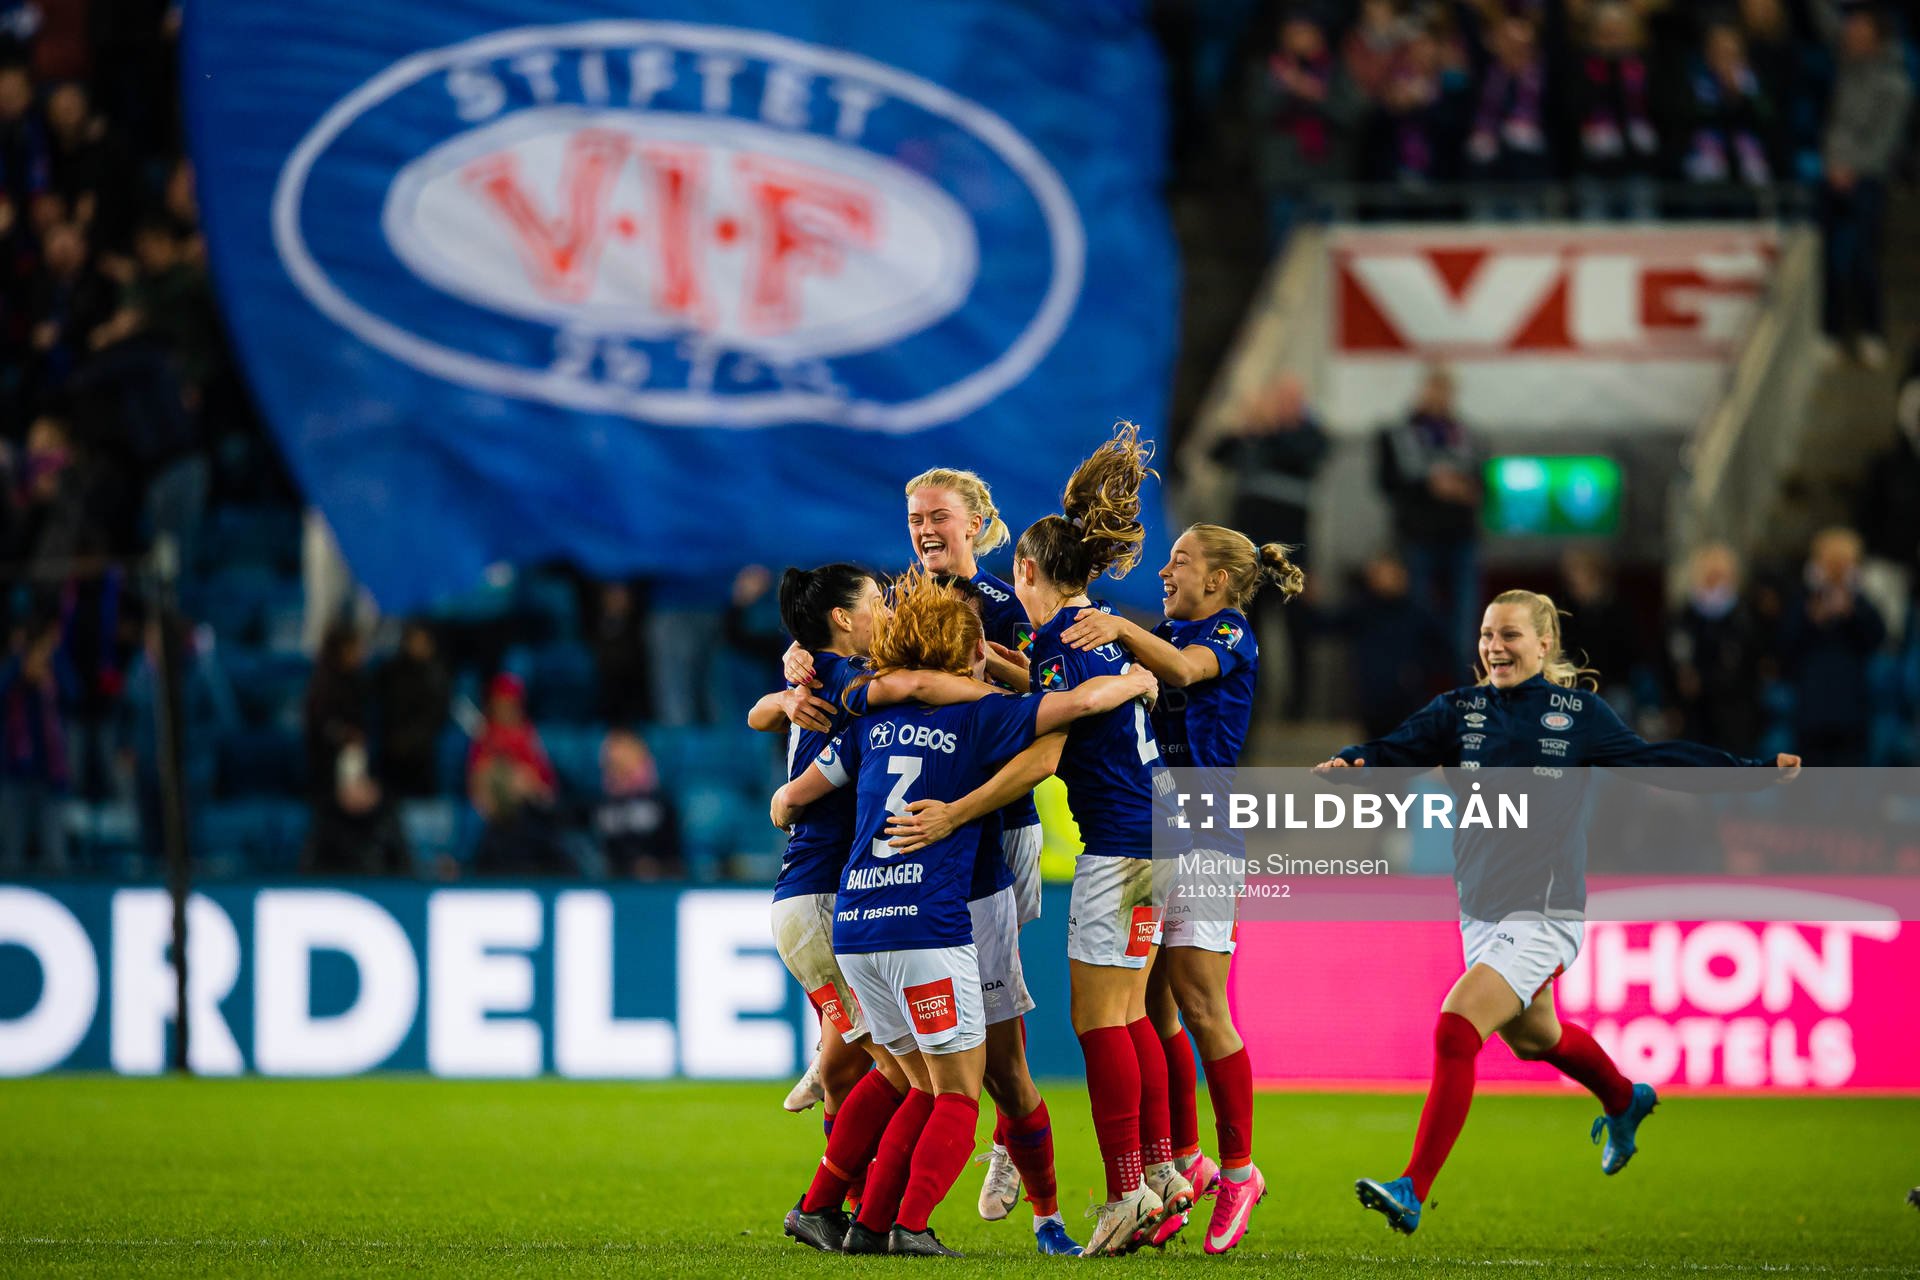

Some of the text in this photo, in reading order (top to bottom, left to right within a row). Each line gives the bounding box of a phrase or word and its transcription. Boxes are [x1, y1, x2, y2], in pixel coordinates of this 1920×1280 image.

[446, 47, 884, 139] STIFTET
[1346, 250, 1768, 346] VG
[977, 582, 1010, 602] coop
[1456, 696, 1487, 710] DNB
[1550, 694, 1583, 711] DNB
[898, 724, 957, 754] OBOS
[1538, 738, 1570, 750] THON
[1533, 766, 1563, 779] coop
[872, 756, 923, 858] 3
[846, 863, 924, 890] BALLISAGER
[837, 904, 919, 922] mot rasisme
[0, 886, 822, 1079] ORDELE
[912, 994, 951, 1012] THON
[918, 1008, 949, 1020] HOTELS
